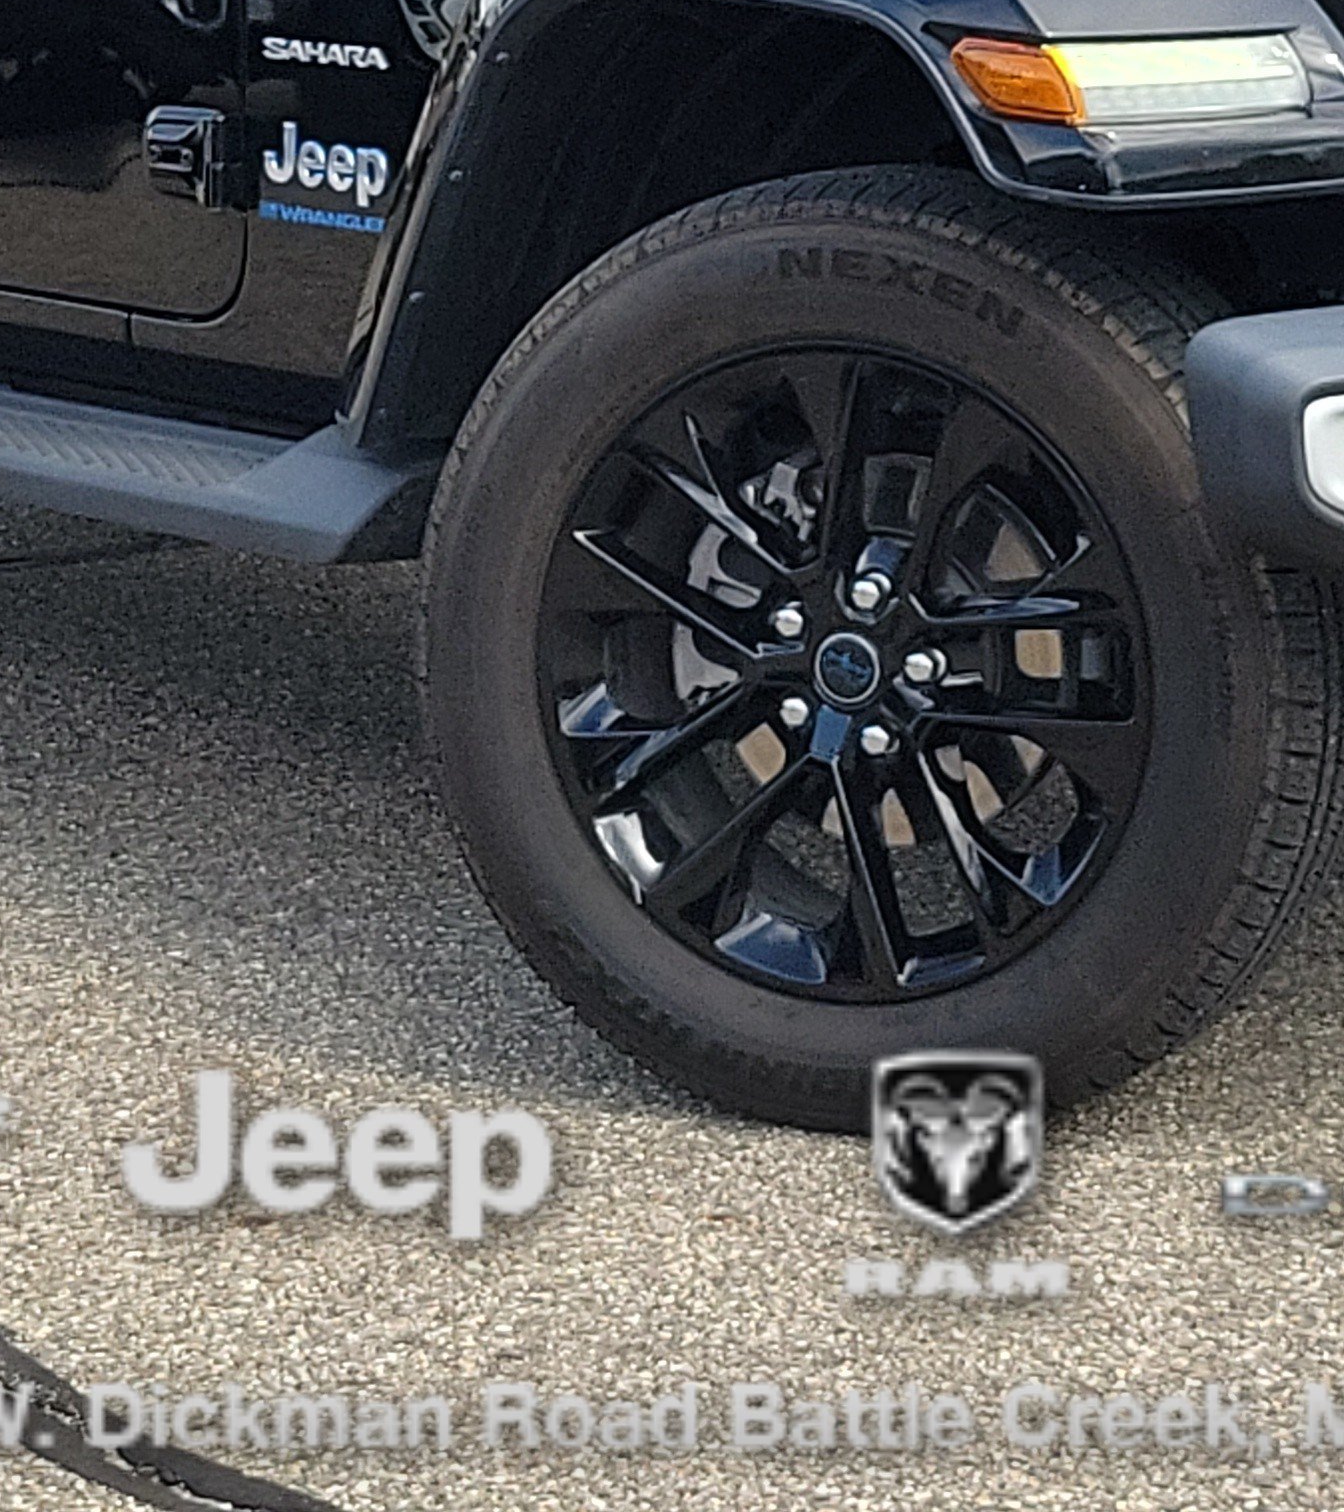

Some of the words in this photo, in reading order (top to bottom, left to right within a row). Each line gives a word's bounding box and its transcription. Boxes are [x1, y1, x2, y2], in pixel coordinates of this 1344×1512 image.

[261, 36, 391, 71] SAHARA
[262, 120, 389, 208] Jeep
[777, 246, 1025, 337] NEXEN
